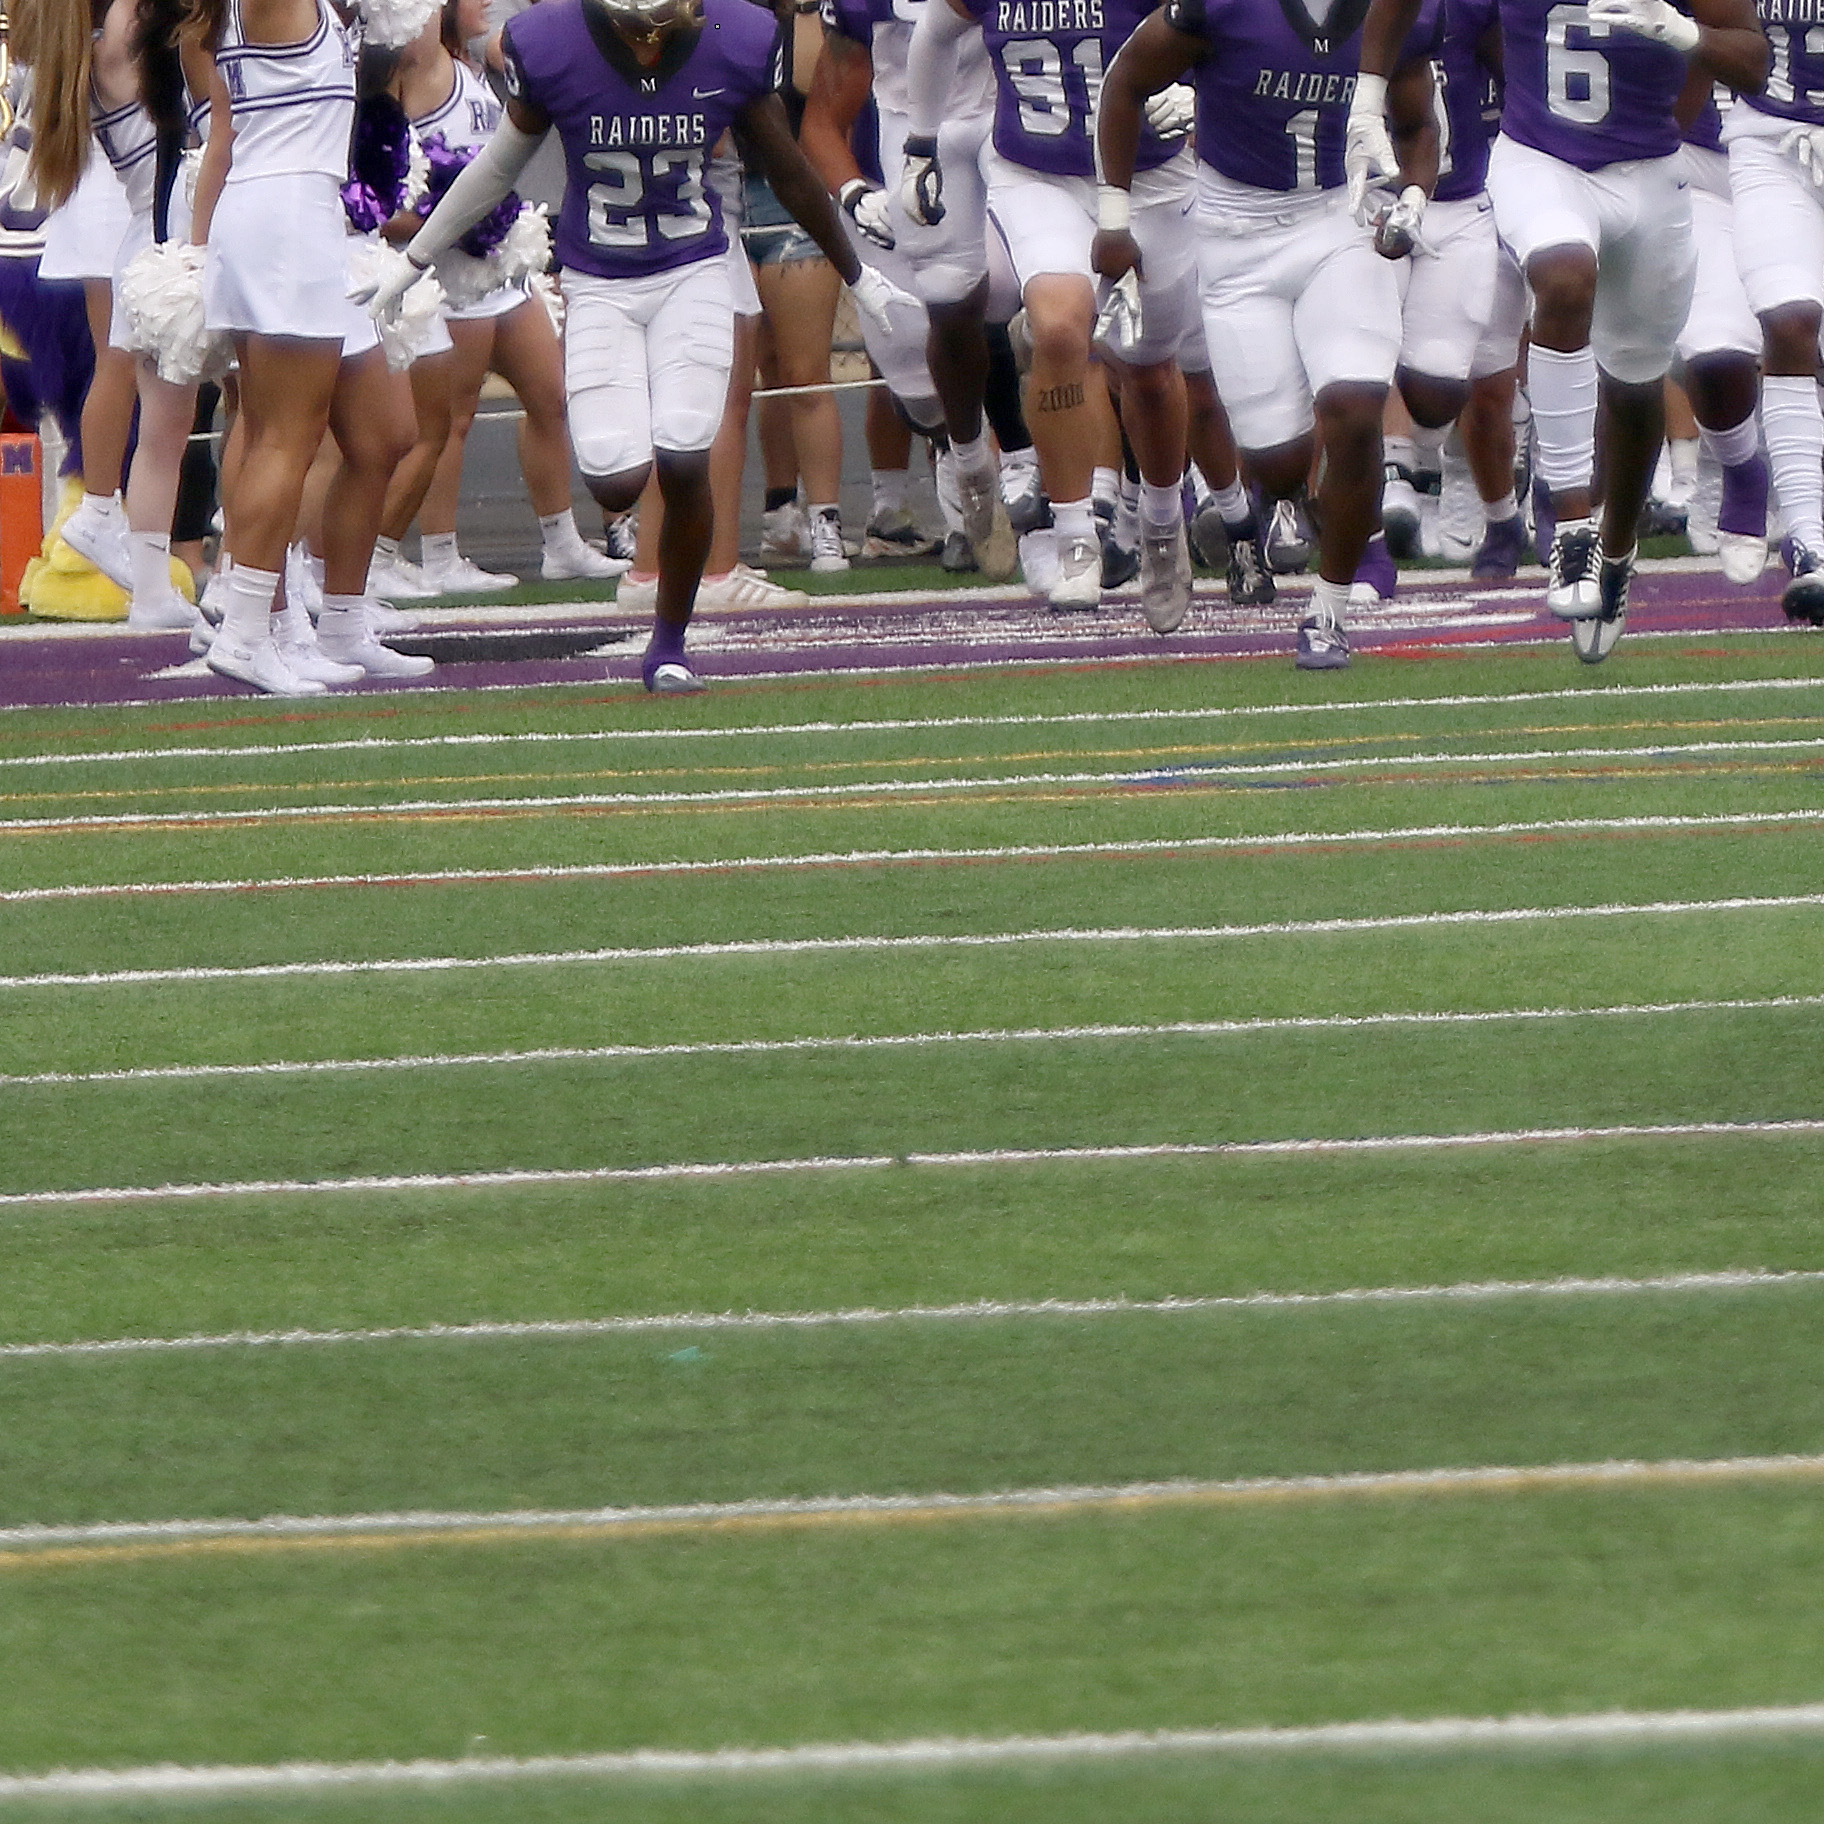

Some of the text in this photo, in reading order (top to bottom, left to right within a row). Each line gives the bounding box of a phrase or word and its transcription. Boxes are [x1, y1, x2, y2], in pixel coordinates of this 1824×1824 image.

[1313, 37, 1330, 54] M
[1545, 2, 1611, 125] 6
[1253, 69, 1356, 103] RAIDER
[590, 113, 706, 146] RAIDERS
[582, 148, 712, 247] 23
